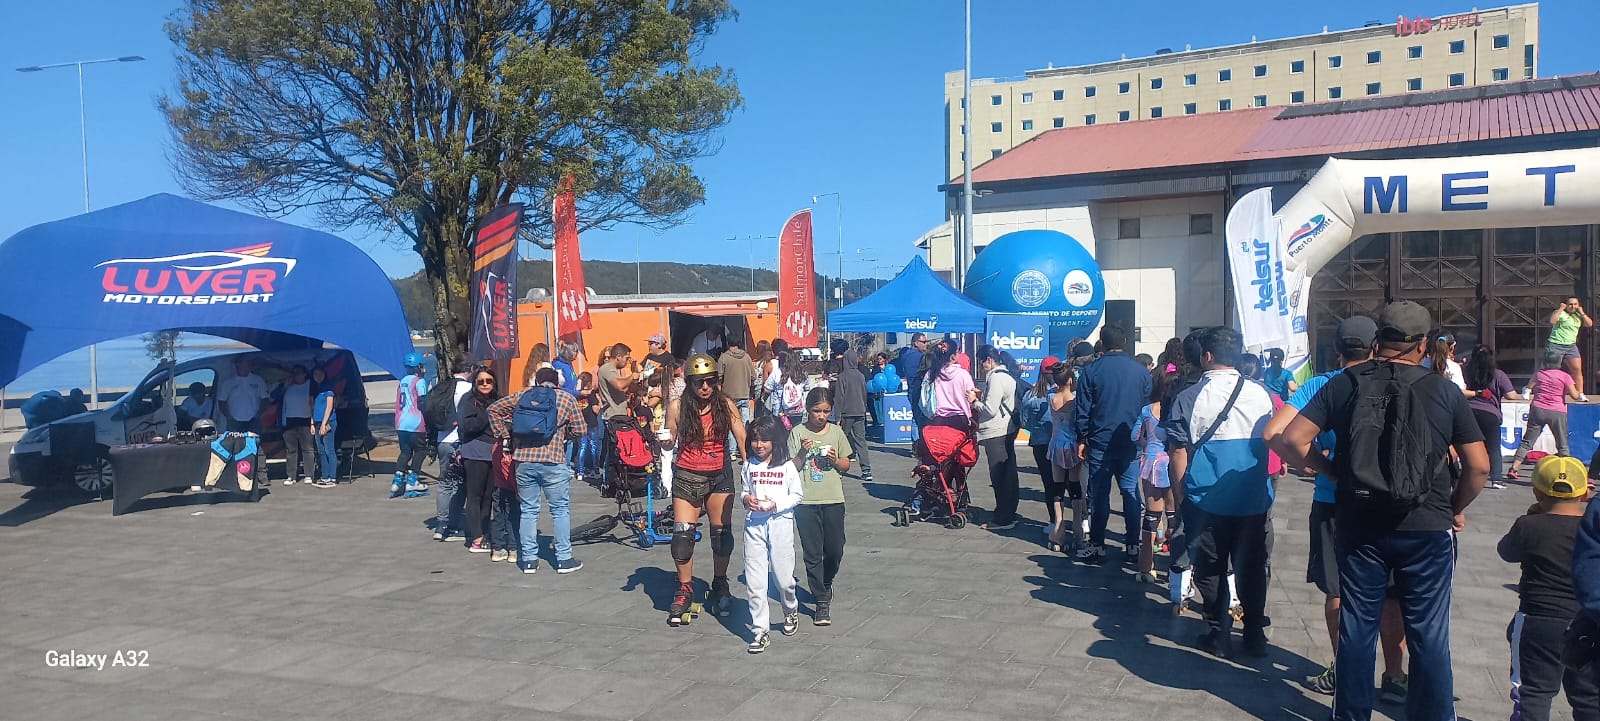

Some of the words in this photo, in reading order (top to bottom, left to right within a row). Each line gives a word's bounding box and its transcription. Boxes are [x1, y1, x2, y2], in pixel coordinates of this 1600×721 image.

[1395, 15, 1432, 36] ibis
[1288, 237, 1313, 257] Puerto
[793, 220, 805, 306] SalmonChile
[102, 266, 277, 294] LUVER
[1251, 238, 1273, 311] telsur
[103, 293, 273, 305] MOTORSPORT
[492, 280, 509, 349] LUVER
[904, 318, 937, 330] telsur
[991, 331, 1044, 350] telsur
[888, 406, 913, 421] tels
